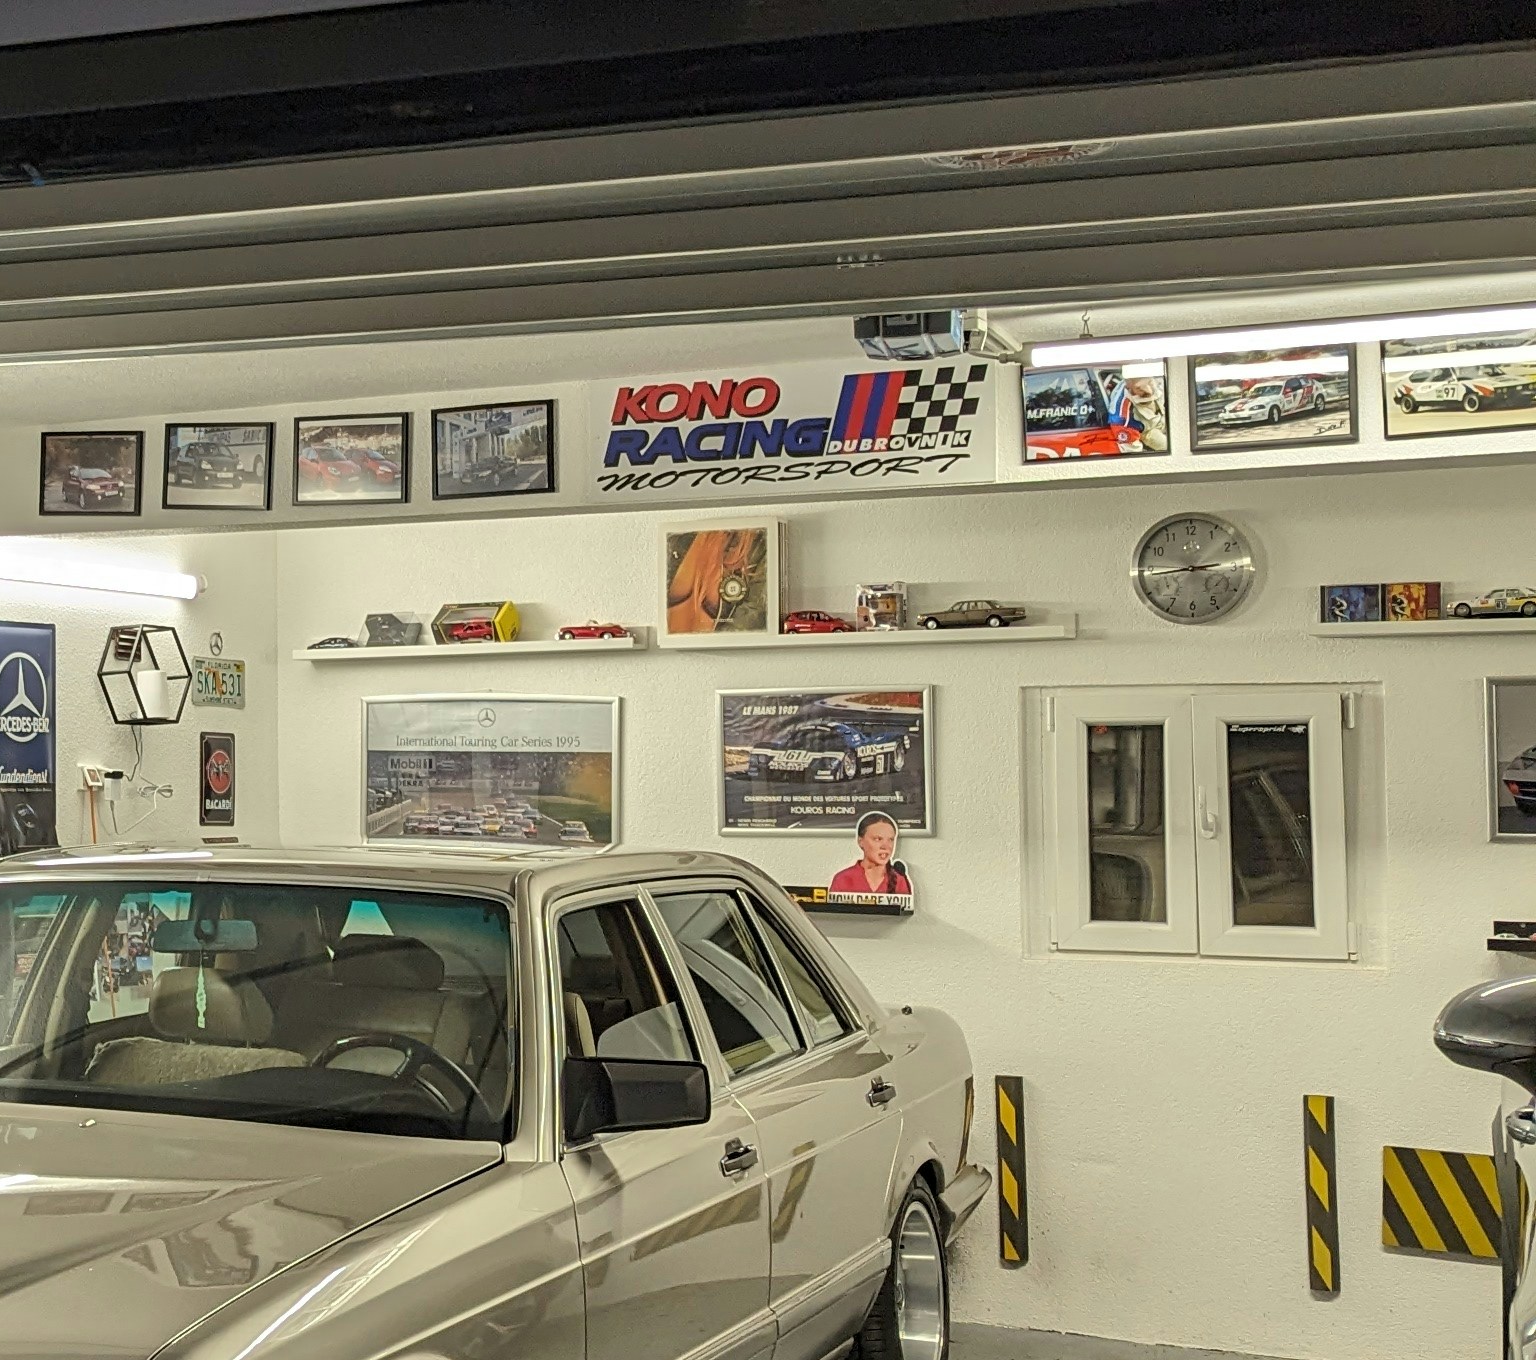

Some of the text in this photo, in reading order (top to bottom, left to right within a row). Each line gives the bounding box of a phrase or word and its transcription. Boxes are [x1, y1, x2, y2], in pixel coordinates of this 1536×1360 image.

[1444, 387, 1455, 398] 97
[611, 377, 780, 425] KONO
[604, 418, 832, 468] RACING
[828, 432, 971, 455] DUBROVNIK
[597, 454, 970, 493] MOTORSPORT
[1186, 526, 1196, 535] 12
[1210, 531, 1213, 539] 1
[1166, 533, 1175, 542] 11
[1154, 547, 1164, 556] 10
[1224, 543, 1230, 552] 2
[1210, 596, 1216, 605] 5
[1190, 601, 1196, 610] 6
[753, 706, 776, 715] MANS
[778, 706, 798, 714] 1987
[396, 736, 580, 748] International Touring Car Series 1995
[791, 806, 855, 814] KOUROS RACING
